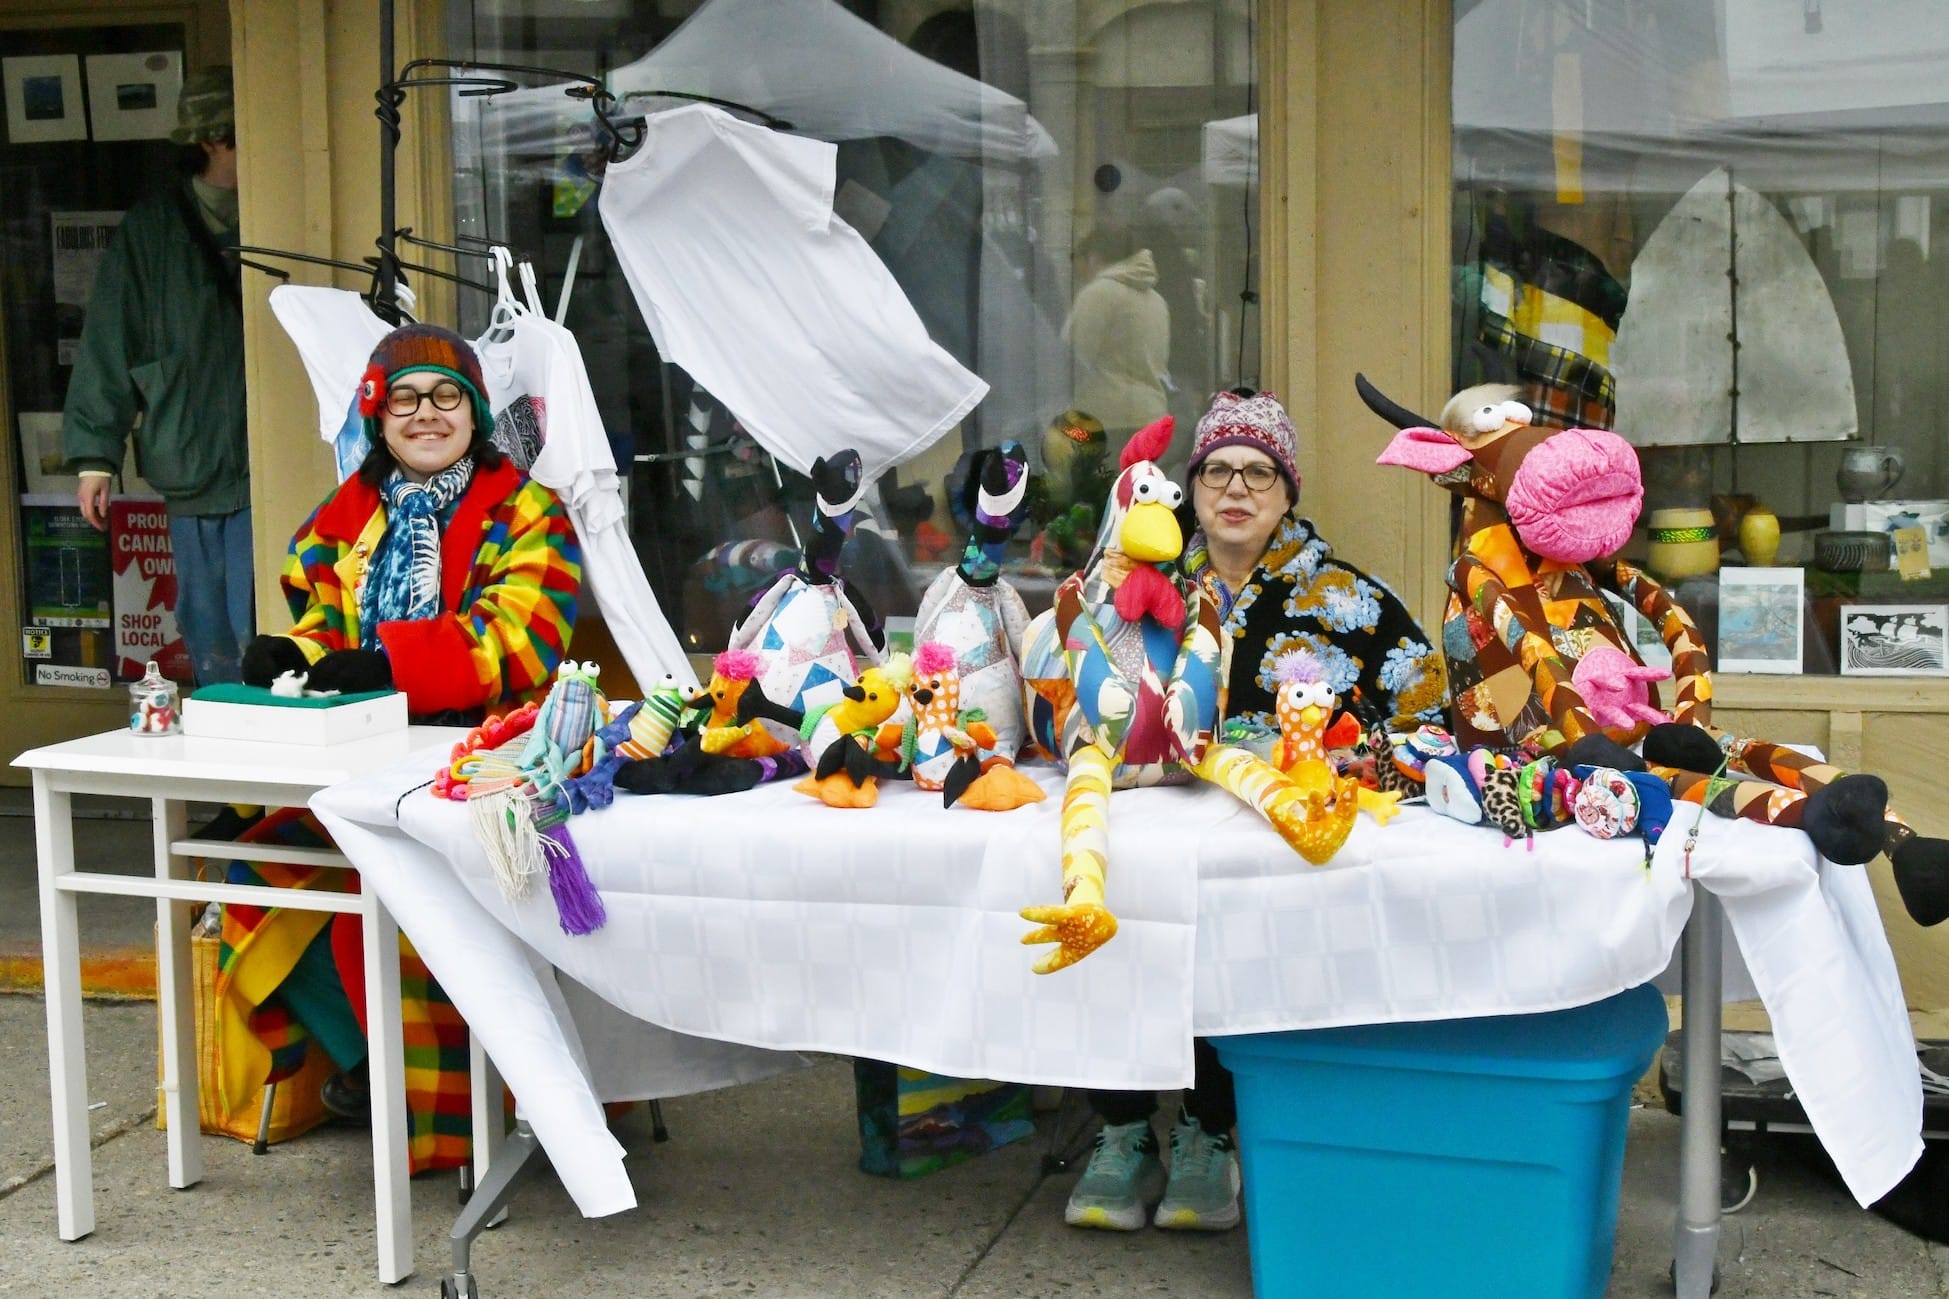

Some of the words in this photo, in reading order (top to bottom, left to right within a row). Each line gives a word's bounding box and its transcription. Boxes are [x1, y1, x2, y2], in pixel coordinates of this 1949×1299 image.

[121, 614, 162, 629] SHOP
[122, 631, 166, 647] LOCAL
[38, 670, 52, 680] No
[54, 670, 95, 685] Smoking
